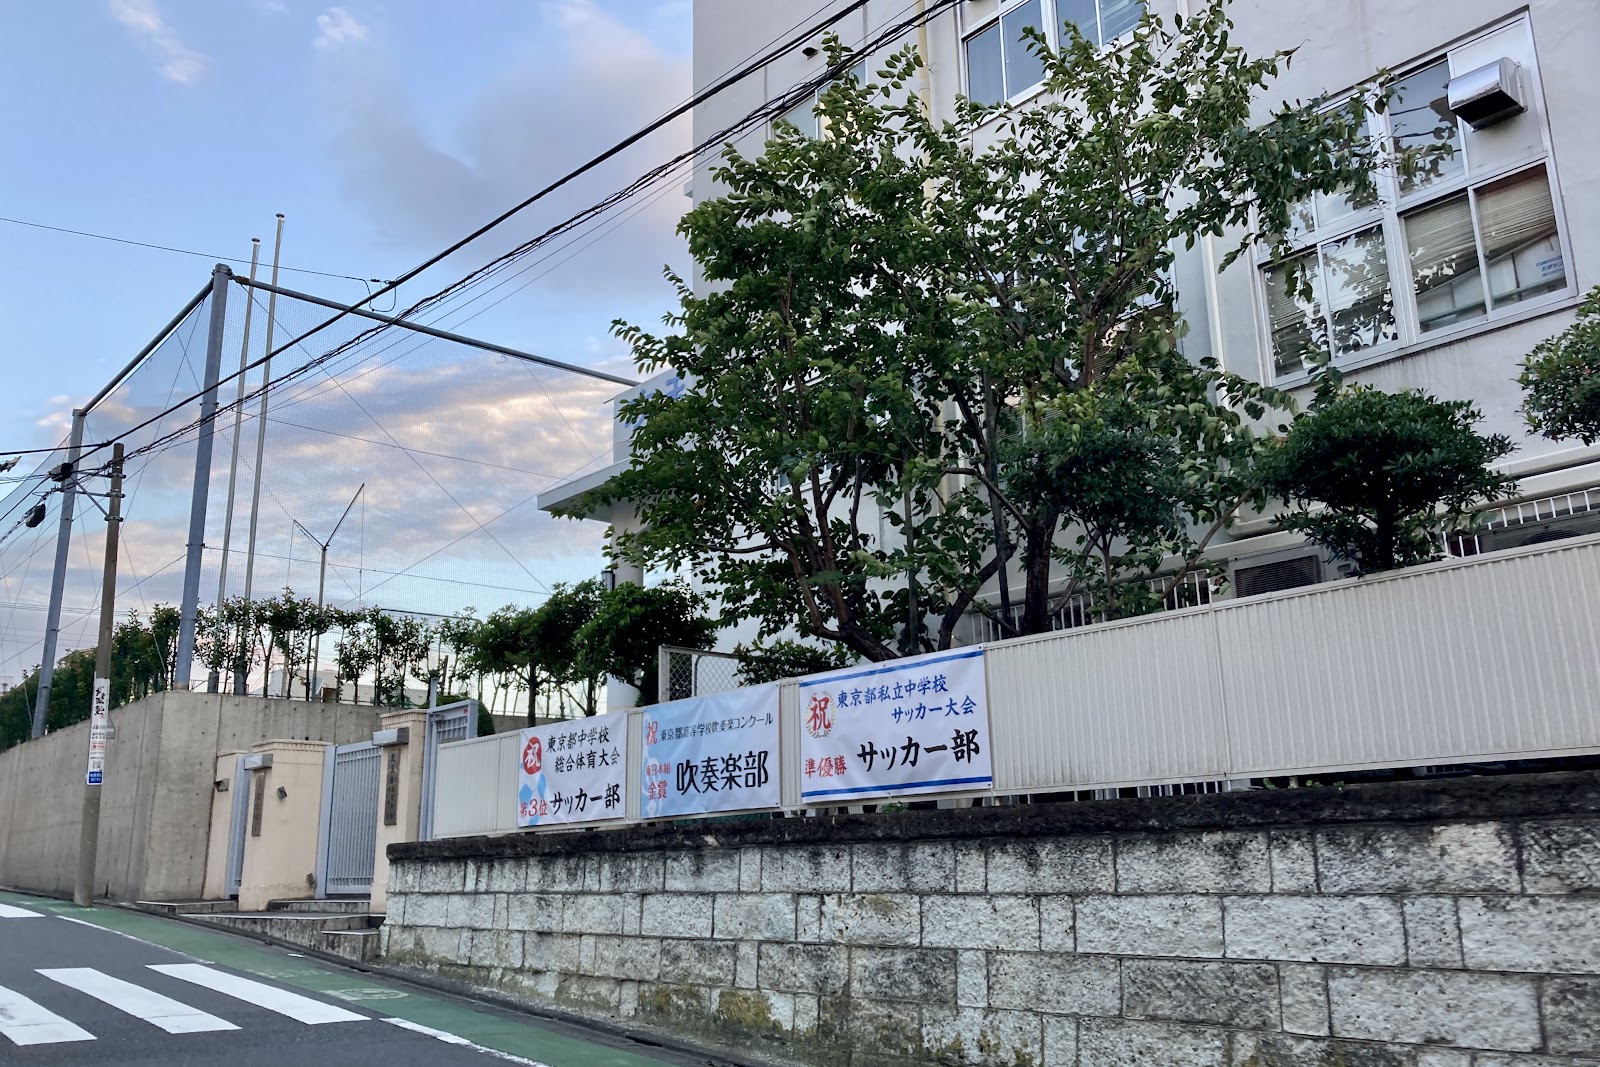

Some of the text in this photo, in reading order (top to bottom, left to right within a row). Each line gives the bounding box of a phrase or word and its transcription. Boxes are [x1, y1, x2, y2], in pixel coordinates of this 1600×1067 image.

[836, 674, 949, 708] 東京都私立中学校
[807, 696, 832, 731] 祝
[891, 695, 977, 724] サッカー大会
[546, 725, 610, 753] 東京都中学校
[645, 721, 658, 746] 祝
[659, 712, 774, 742] 東京都高等学校吹奏楽コンクール
[524, 742, 541, 768] 祝
[554, 746, 620, 773] 総合体育大会
[857, 729, 980, 772] サッカー部
[676, 750, 769, 796] 吹奏楽部
[804, 754, 848, 779] 準優勝
[549, 783, 621, 816] サッカー部
[648, 779, 668, 801] 金賞
[520, 798, 548, 819] 第3位
